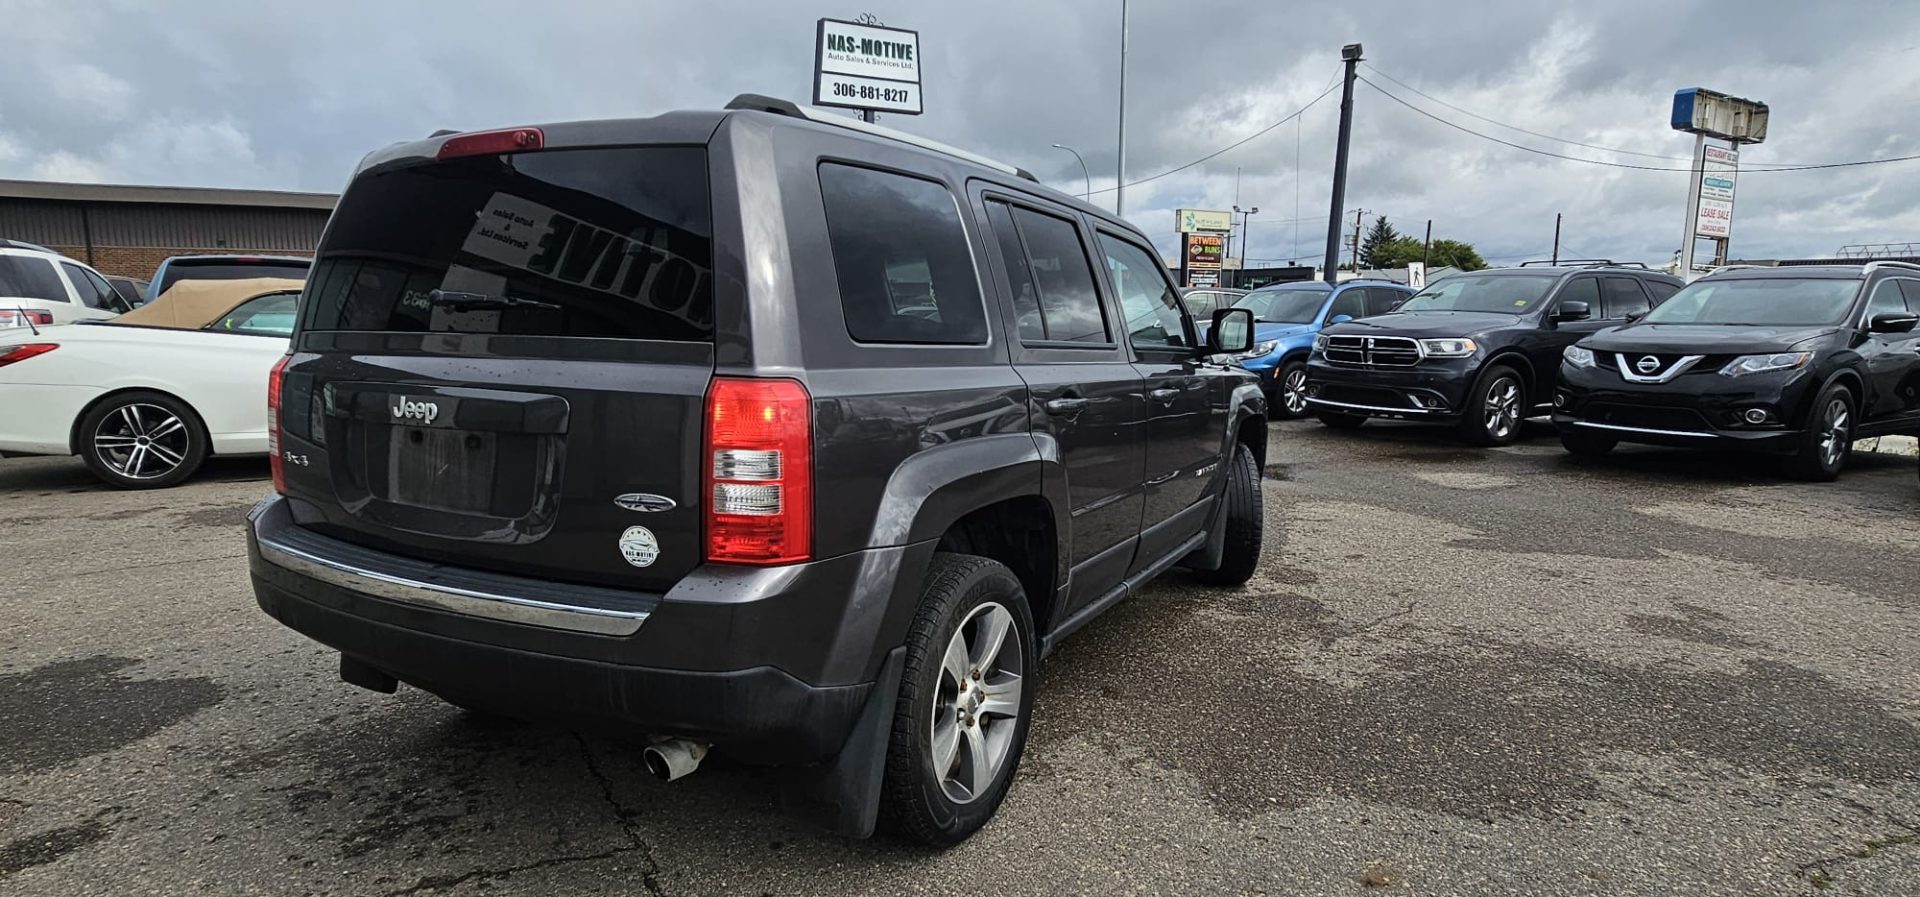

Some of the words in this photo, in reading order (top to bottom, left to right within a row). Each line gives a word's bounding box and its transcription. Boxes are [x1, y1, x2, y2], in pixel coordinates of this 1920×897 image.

[827, 34, 912, 60] NAS-MOTIVE
[828, 52, 844, 61] Auto
[846, 55, 864, 63] Sales
[872, 58, 900, 68] Services
[833, 82, 908, 103] 306-881-8217
[1701, 208, 1717, 219] LEASE
[1717, 210, 1730, 220] SALE
[1190, 236, 1220, 246] BETWEEN
[1204, 246, 1221, 254] BUNS
[393, 395, 438, 424] Jeep
